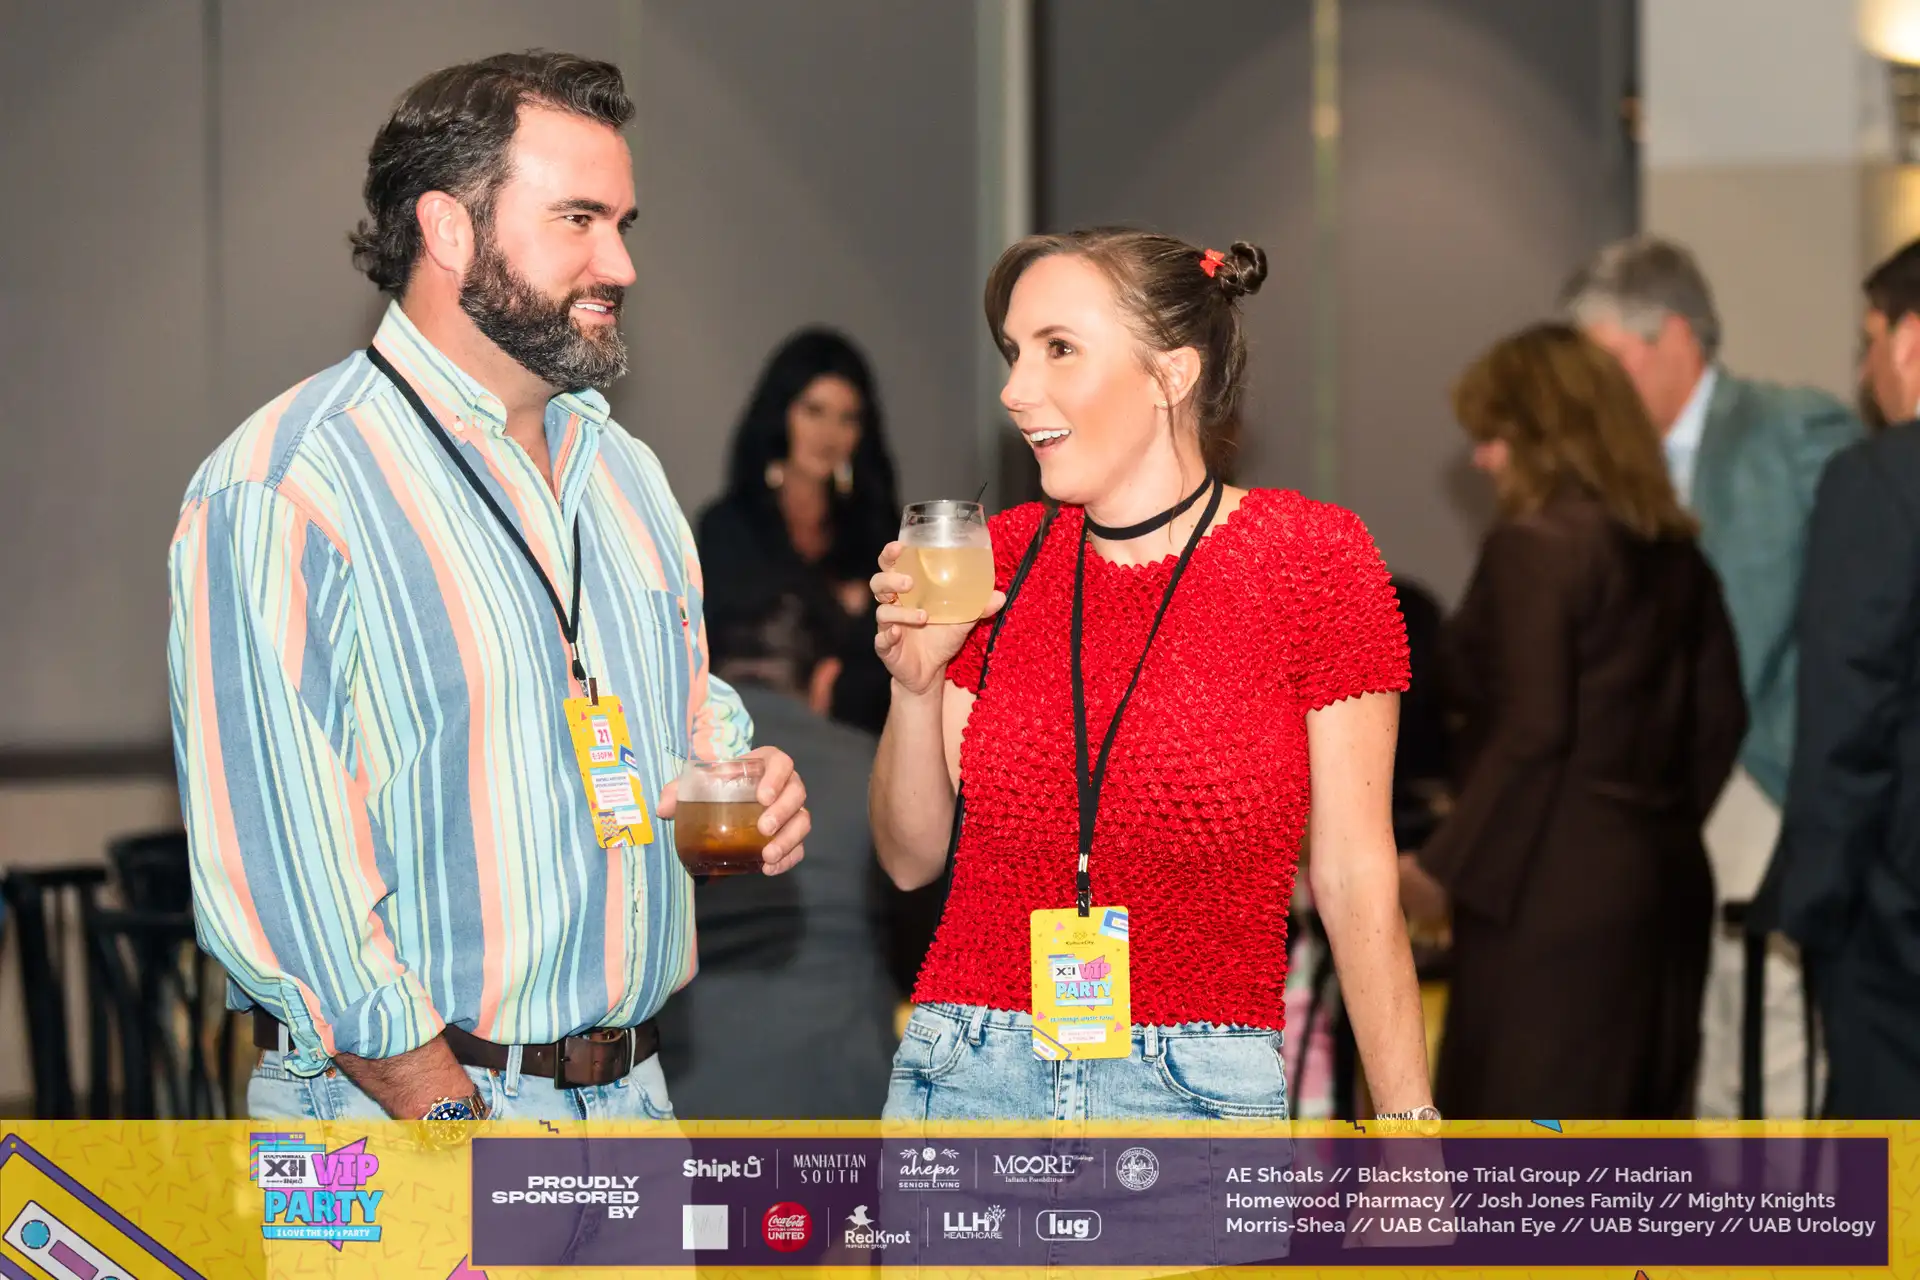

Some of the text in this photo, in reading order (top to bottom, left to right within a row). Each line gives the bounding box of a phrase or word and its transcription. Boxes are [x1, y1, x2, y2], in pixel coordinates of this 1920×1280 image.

[597, 729, 610, 743] 21
[1078, 962, 1111, 980] VIP
[1055, 981, 1113, 999] PARTY
